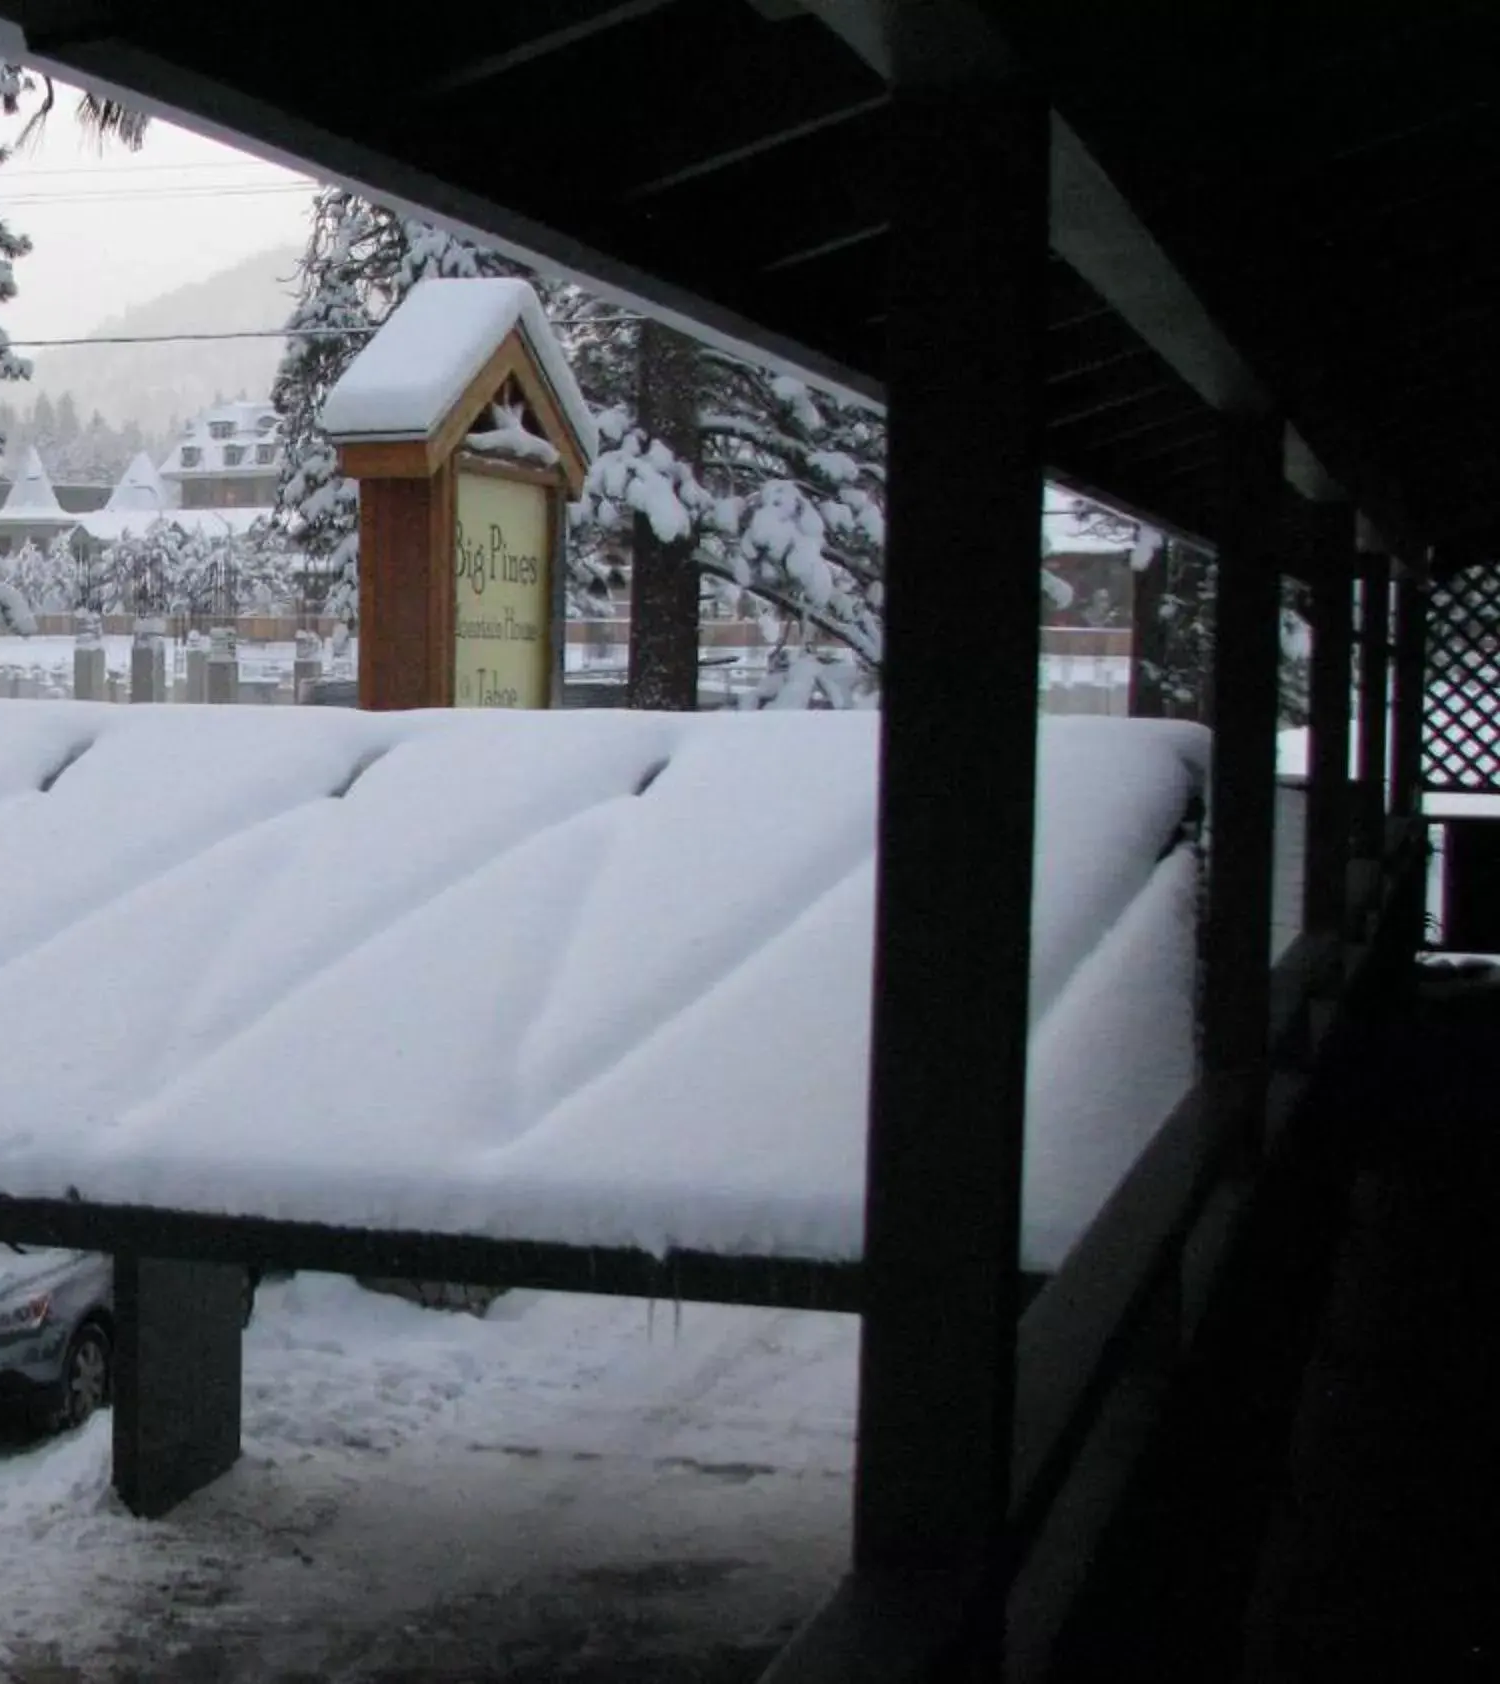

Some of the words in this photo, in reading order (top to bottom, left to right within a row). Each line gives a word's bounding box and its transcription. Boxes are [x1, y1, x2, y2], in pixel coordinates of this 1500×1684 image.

[455, 520, 486, 595] Big
[489, 524, 537, 585] Pines
[476, 668, 517, 706] Tahoe
